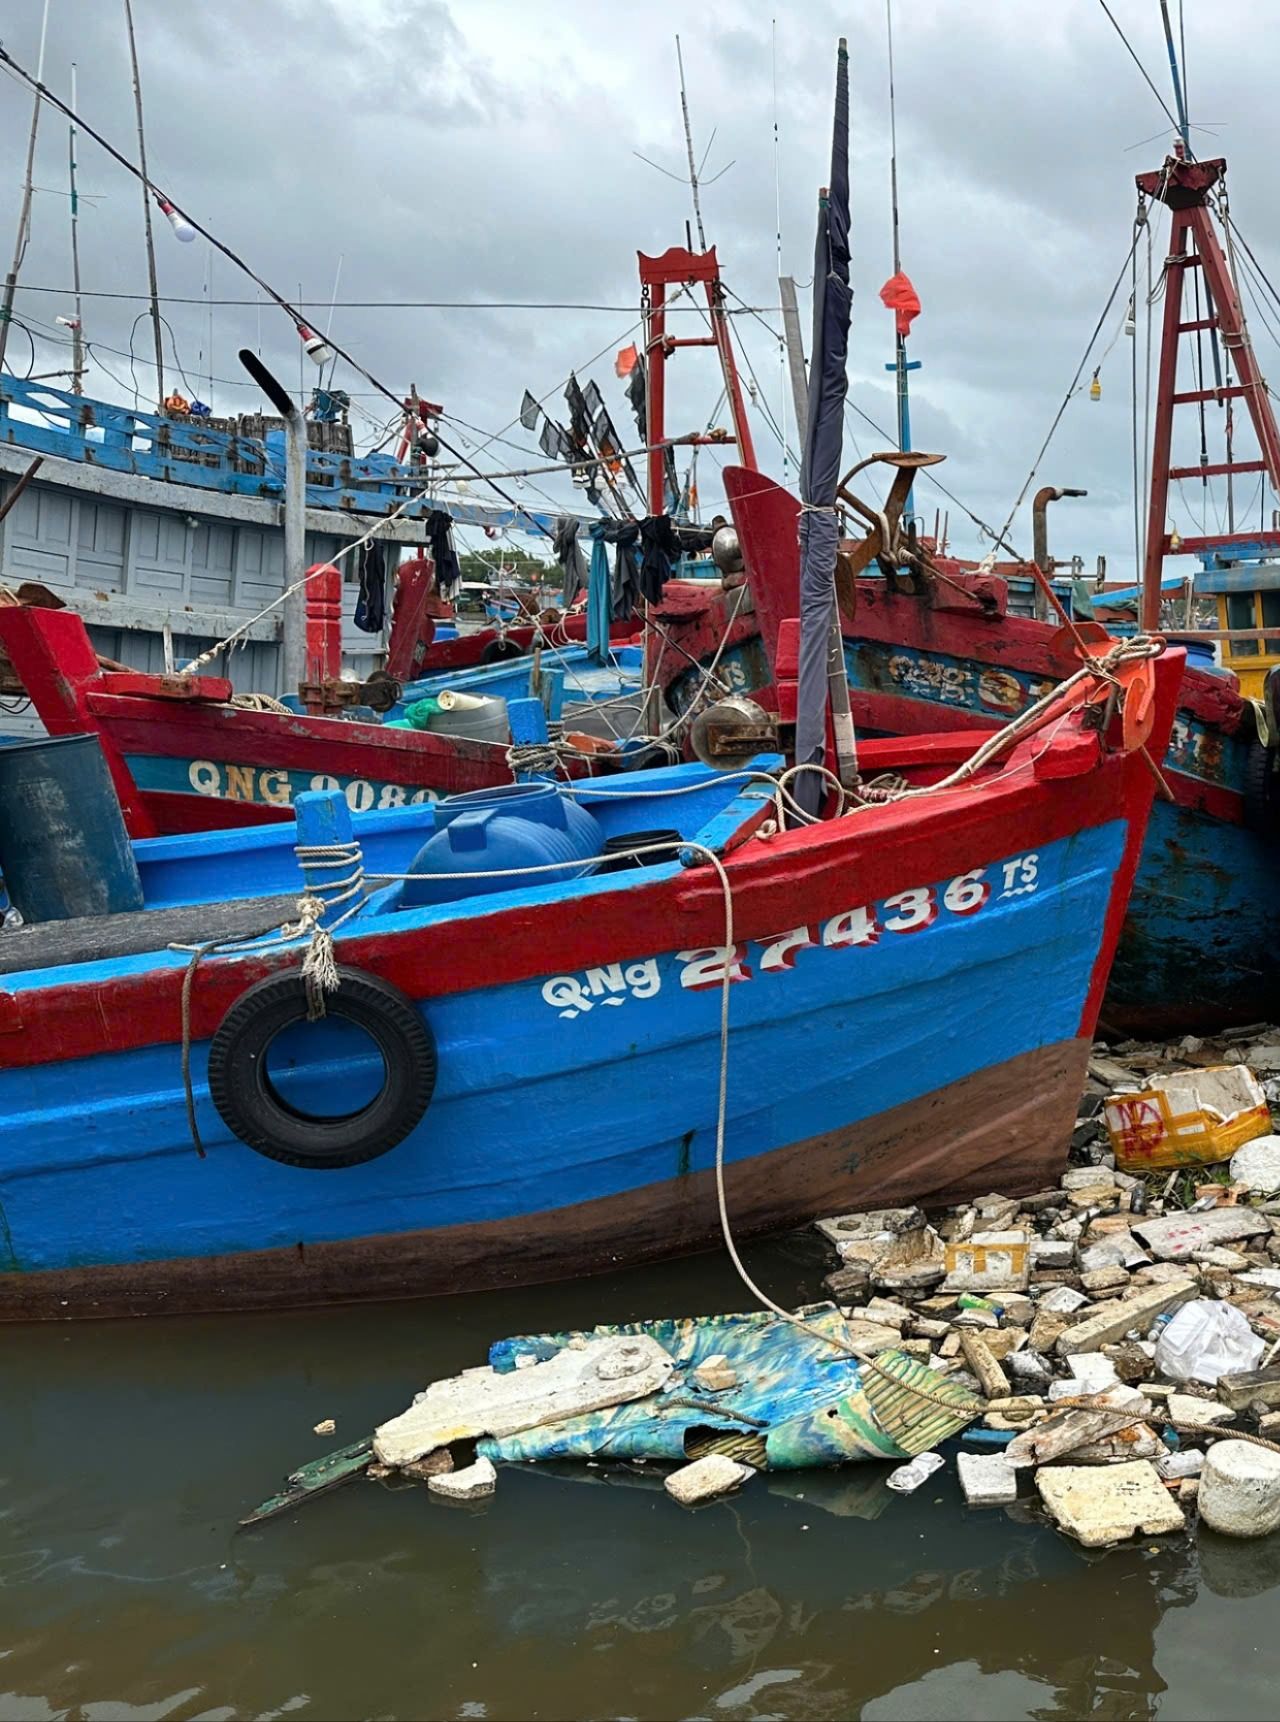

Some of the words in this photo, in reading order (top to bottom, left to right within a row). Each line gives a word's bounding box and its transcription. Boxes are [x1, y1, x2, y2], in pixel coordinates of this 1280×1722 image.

[188, 759, 292, 809] QNG
[674, 868, 992, 991] 27436
[1002, 854, 1040, 891] TS
